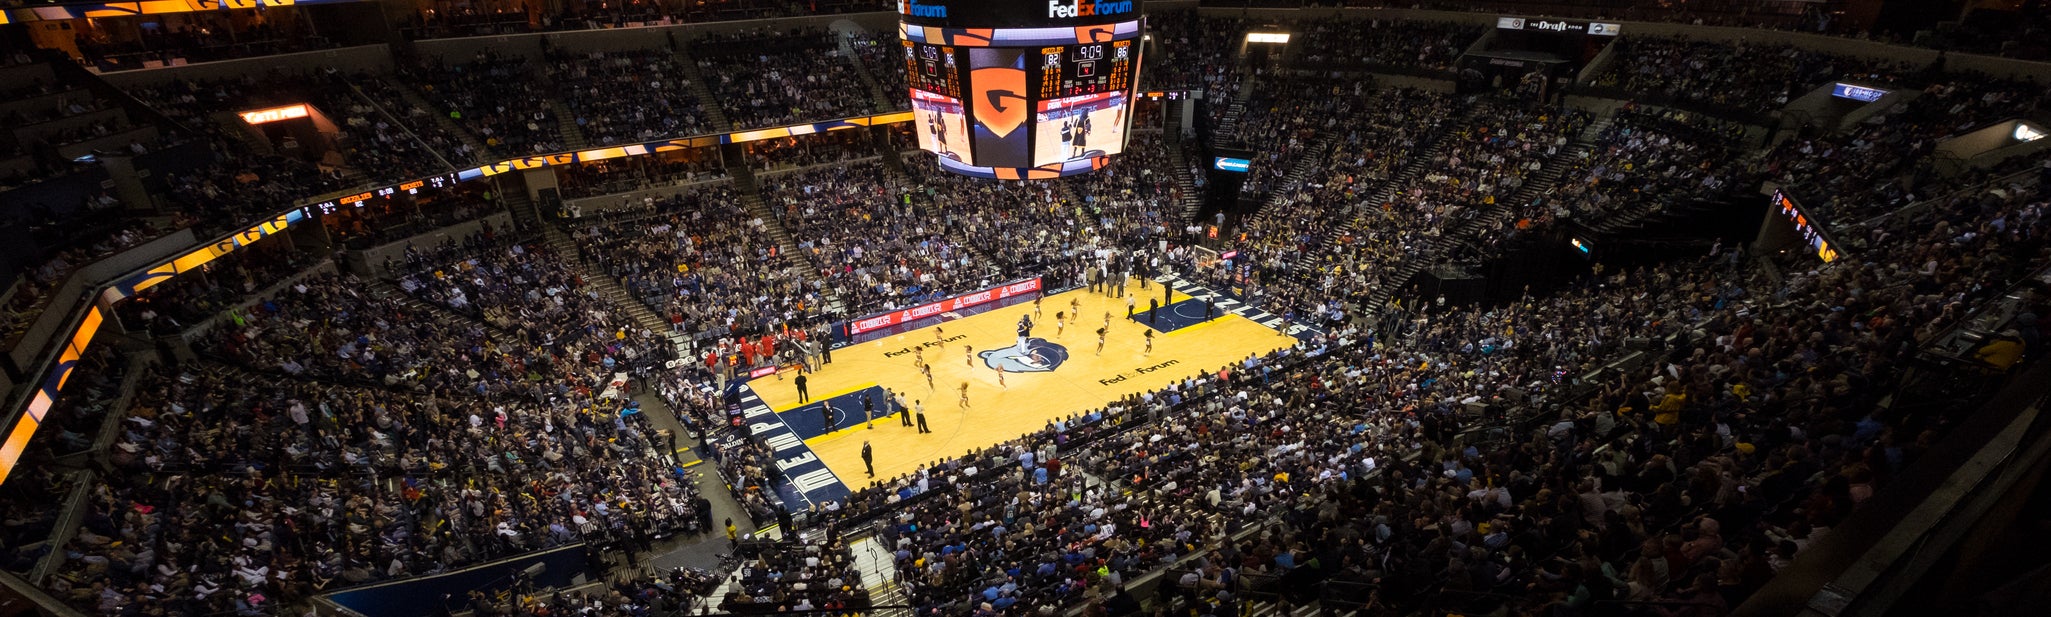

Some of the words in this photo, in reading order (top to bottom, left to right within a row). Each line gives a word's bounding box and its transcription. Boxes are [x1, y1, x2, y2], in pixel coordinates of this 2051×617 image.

[1048, 0, 1132, 18] FedExForum
[1538, 21, 1567, 32] Draft
[1117, 47, 1128, 58] 86
[1048, 54, 1059, 65] 82
